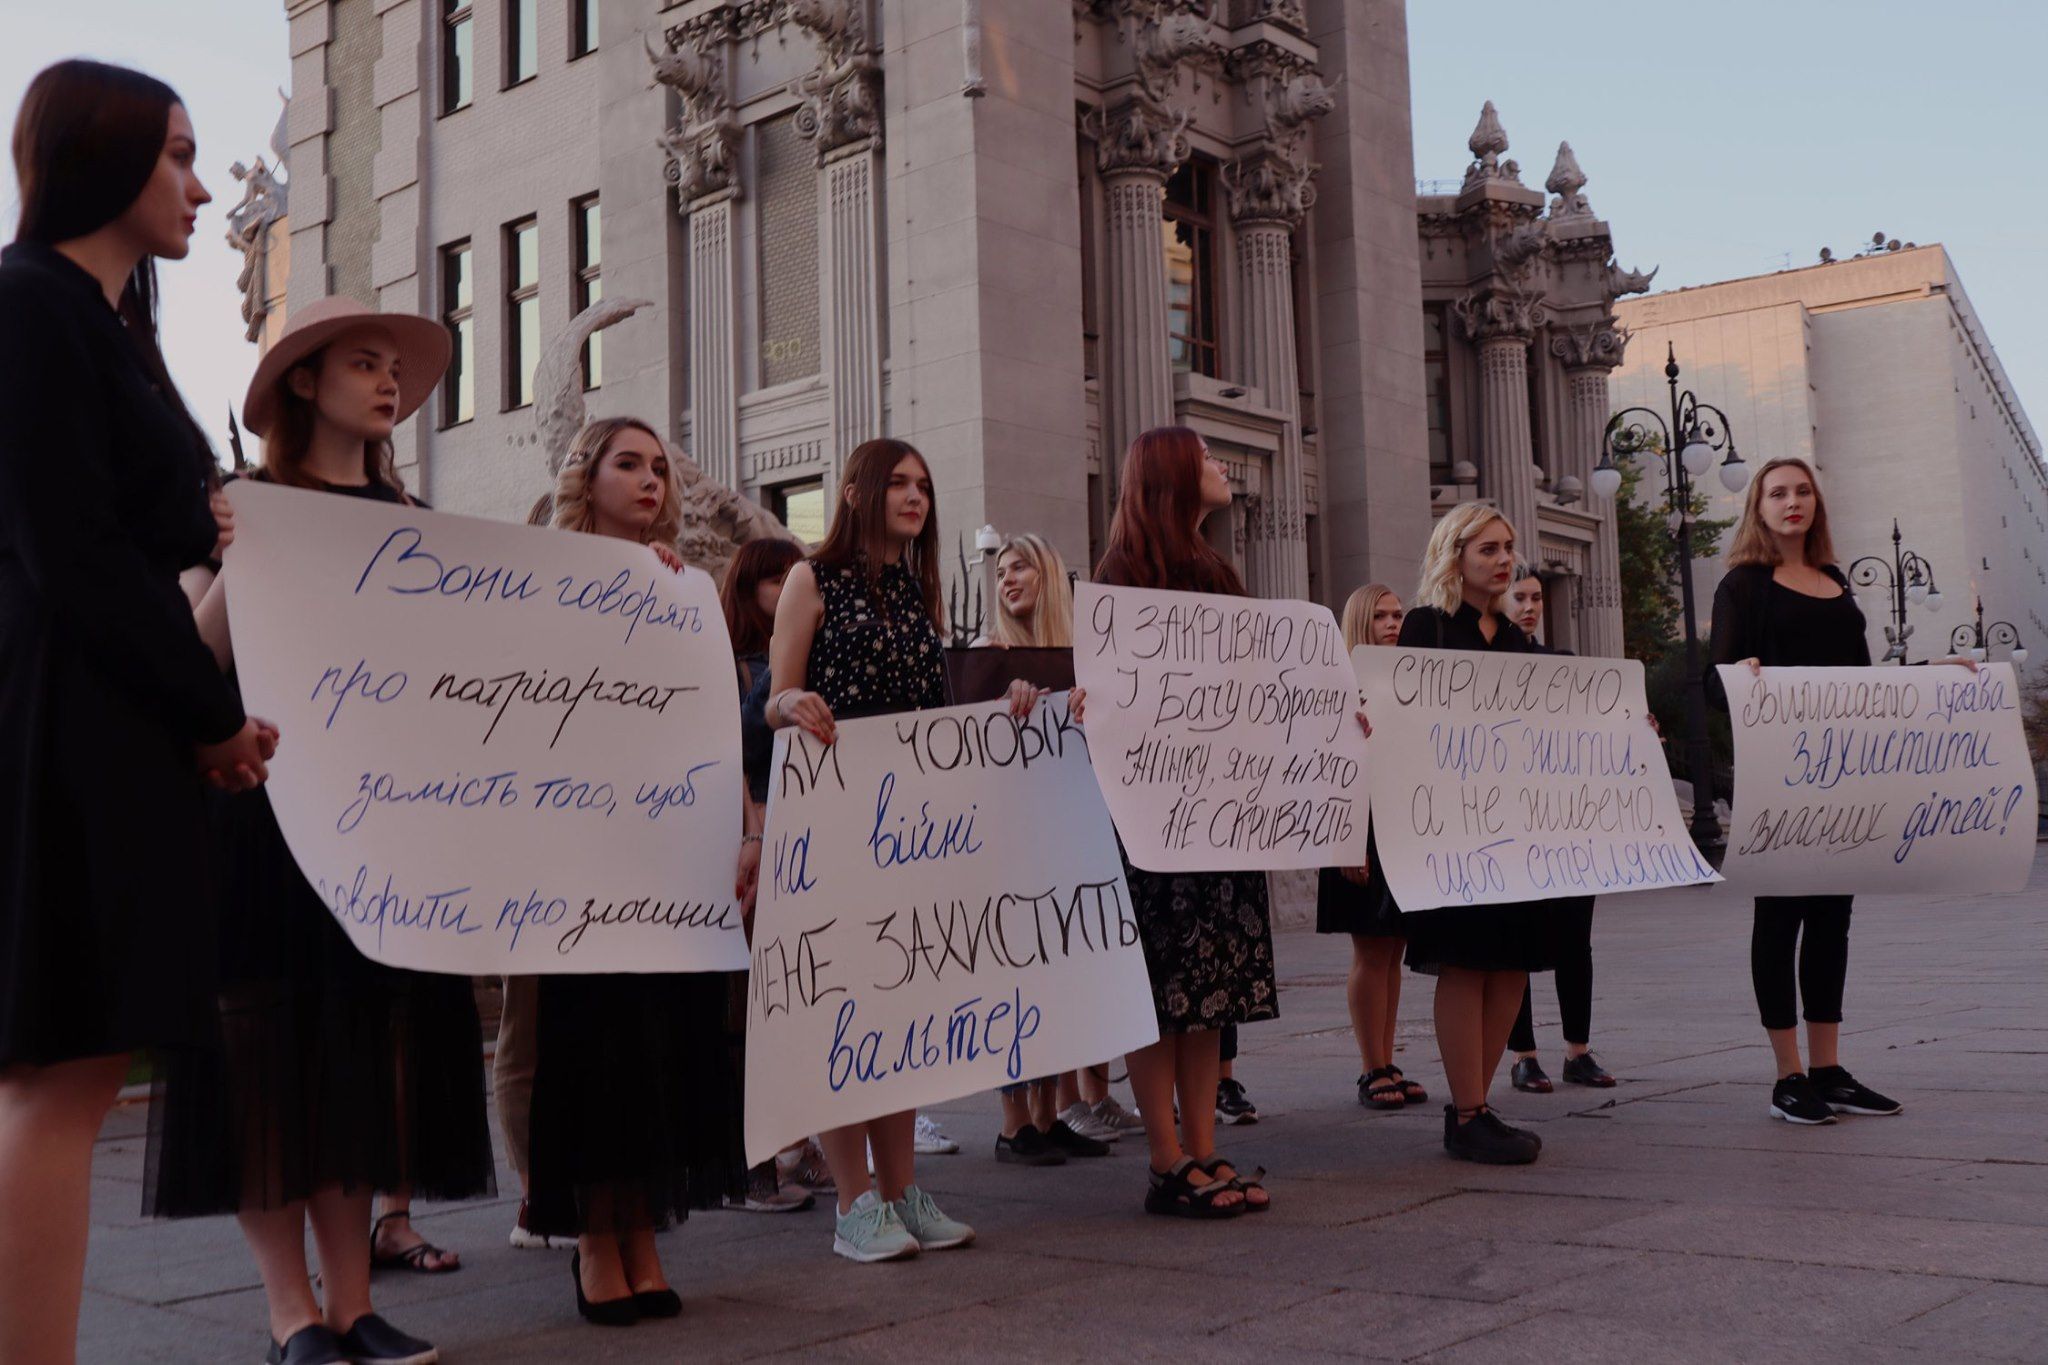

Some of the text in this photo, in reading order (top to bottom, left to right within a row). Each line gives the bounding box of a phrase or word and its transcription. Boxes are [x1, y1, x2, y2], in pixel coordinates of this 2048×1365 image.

[355, 527, 703, 645] Вони говорять
[1092, 594, 1117, 657] Я
[1131, 603, 1293, 665] ЗАКРИВАЮ
[311, 659, 699, 748] про патріархат
[896, 697, 1093, 775] ЧОЛОВІК
[1154, 672, 1243, 732] Бачу
[1223, 747, 1275, 804] яку
[1430, 719, 1522, 781] щоб
[337, 760, 721, 834] замість того, щоб
[1162, 797, 1207, 850] НЕ
[1412, 784, 1444, 837] а
[774, 772, 982, 900] на війні
[1426, 838, 1515, 903] щоб
[495, 889, 566, 951] про
[558, 896, 741, 955] злочини
[750, 877, 1139, 1031] МЕНЕ ЗАХИСТИТЬ
[828, 987, 1041, 1091] вальтер
